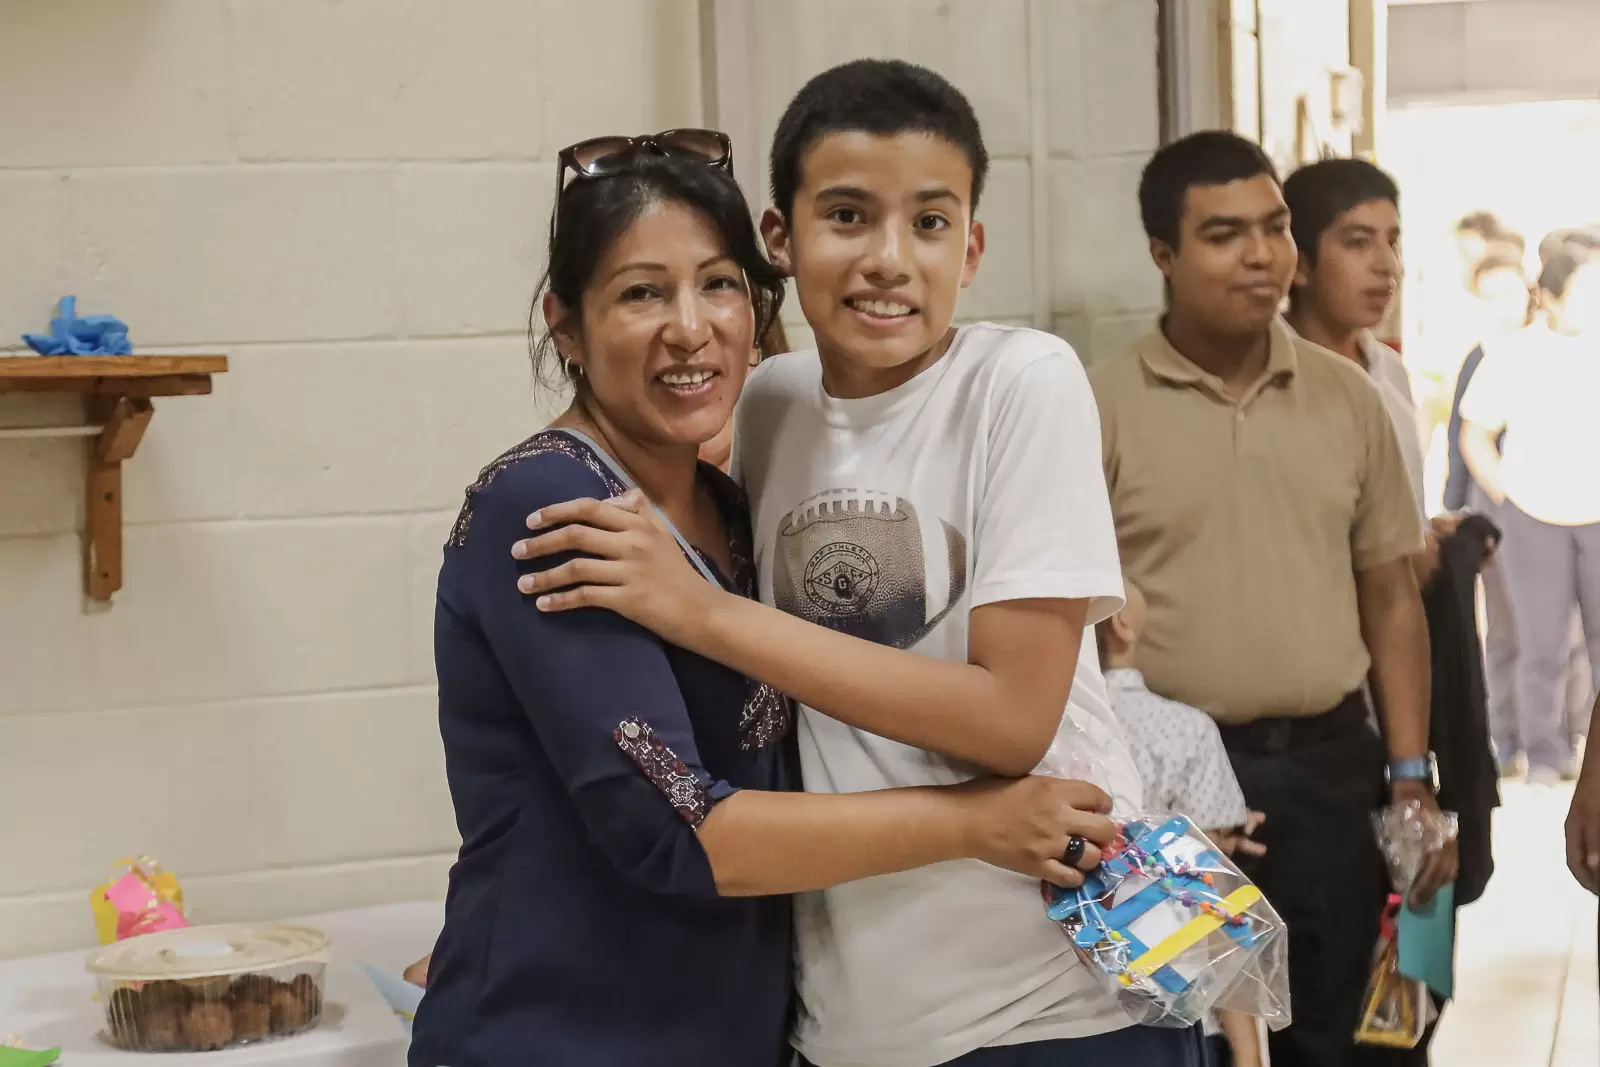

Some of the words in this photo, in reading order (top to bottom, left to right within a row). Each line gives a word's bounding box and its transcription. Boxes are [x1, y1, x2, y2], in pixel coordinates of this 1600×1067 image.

[810, 551, 824, 567] GAP
[828, 544, 872, 562] ATHLETIC
[838, 578, 847, 590] G
